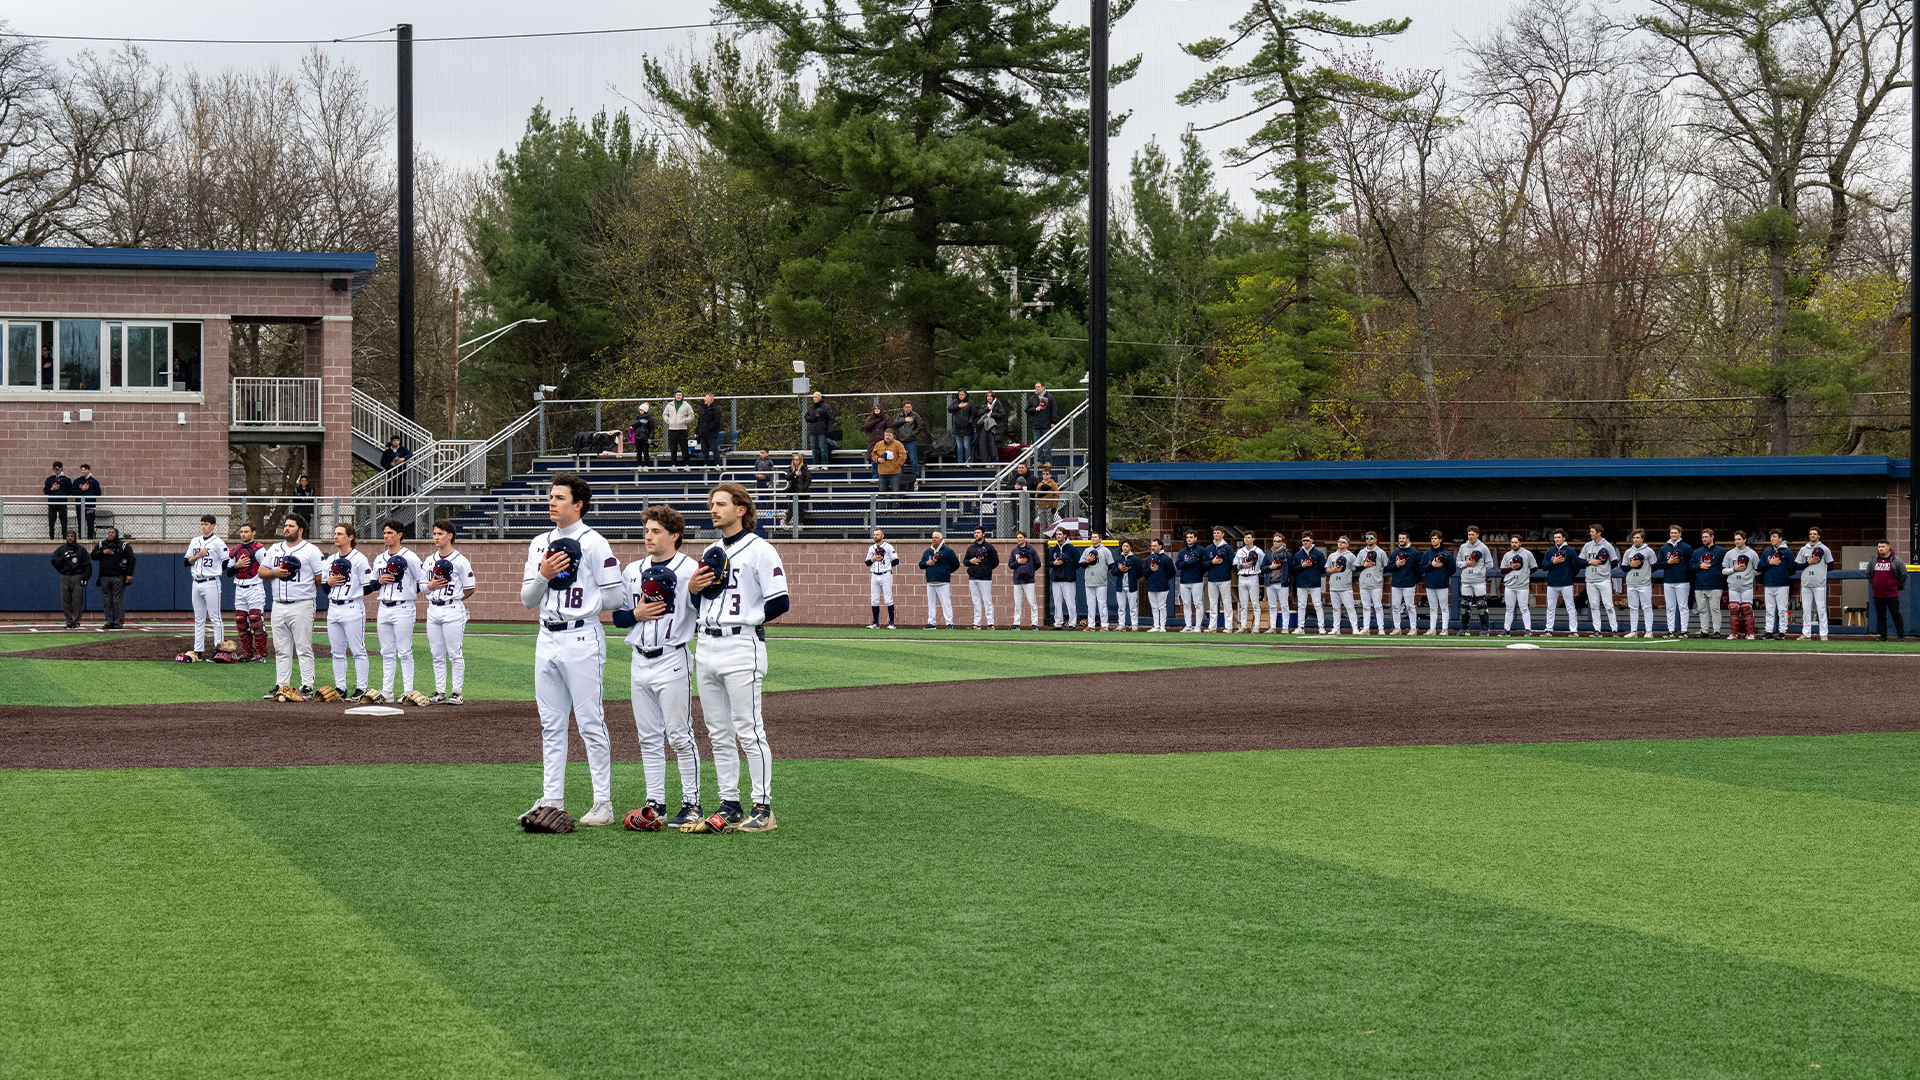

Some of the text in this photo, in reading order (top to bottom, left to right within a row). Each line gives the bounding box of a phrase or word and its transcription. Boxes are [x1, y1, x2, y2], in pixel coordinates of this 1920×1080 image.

[203, 558, 213, 567] 23
[344, 584, 352, 596] 7
[397, 580, 403, 593] 4
[444, 584, 455, 597] 15
[564, 587, 583, 609] 18
[729, 594, 741, 616] 3
